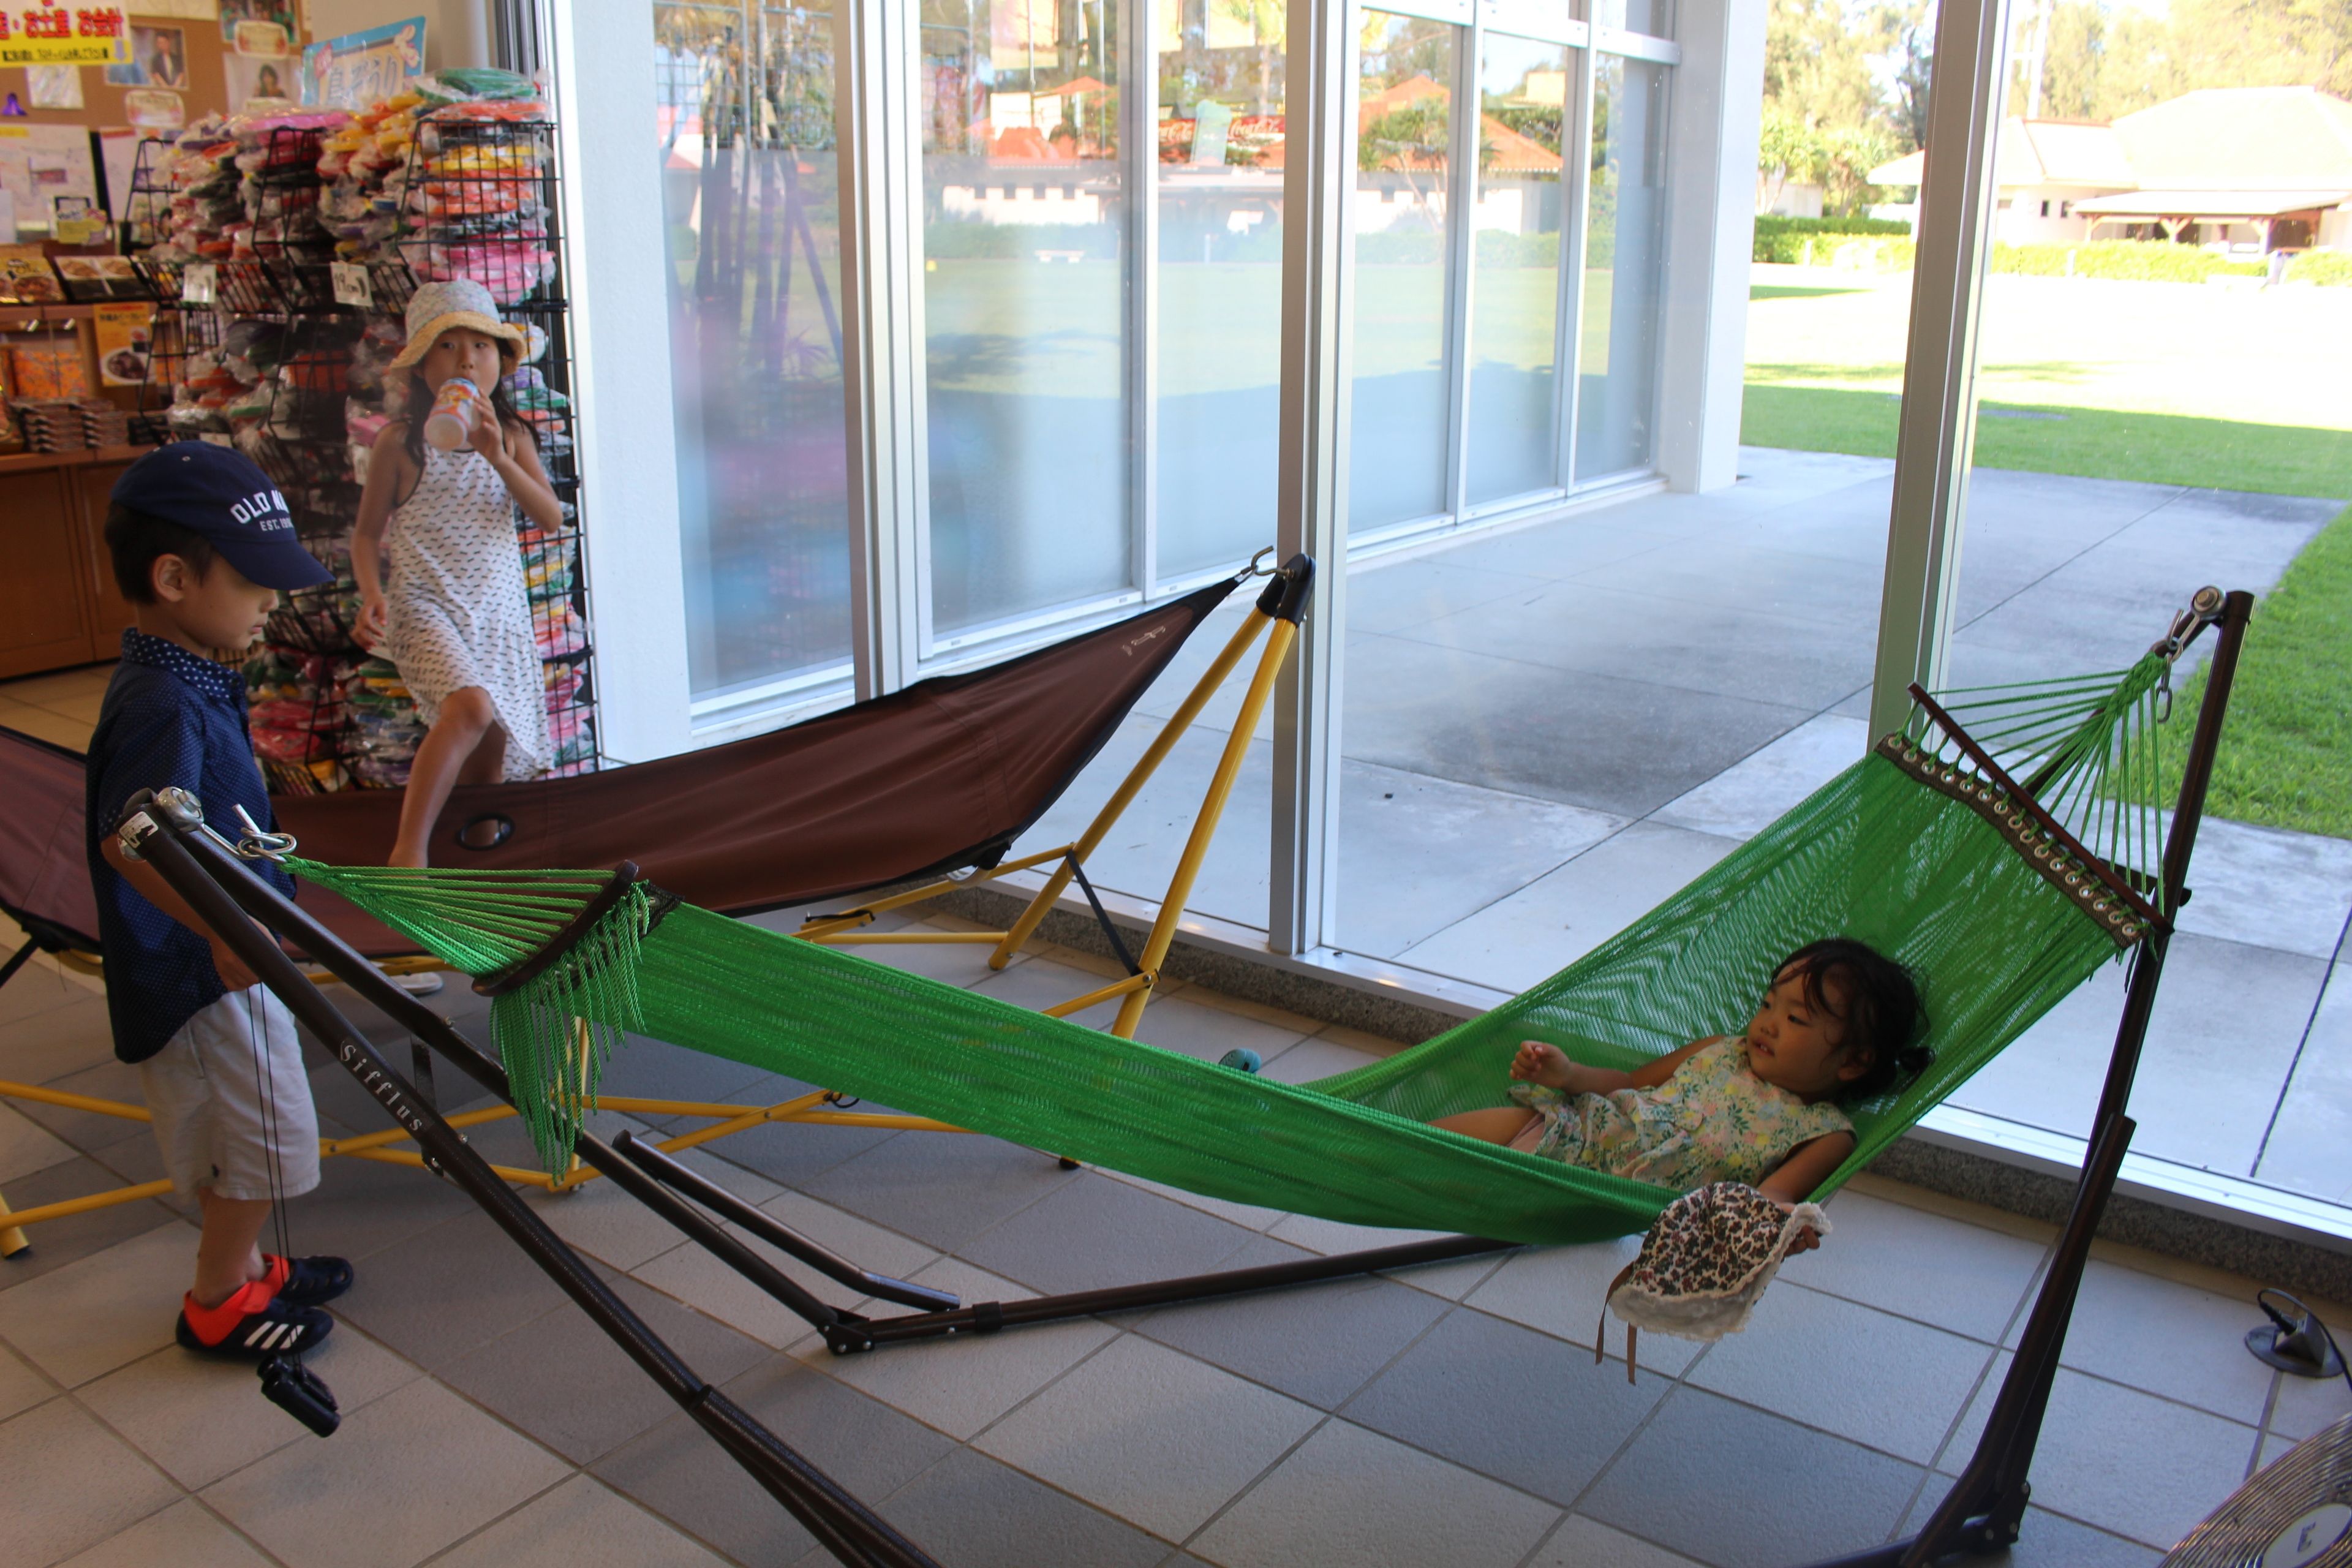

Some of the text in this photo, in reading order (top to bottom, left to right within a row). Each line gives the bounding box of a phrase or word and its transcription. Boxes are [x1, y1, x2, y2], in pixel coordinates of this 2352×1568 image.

[230, 491, 271, 524] OLD
[260, 518, 280, 532] EST.
[340, 1040, 423, 1131] Sifflus
